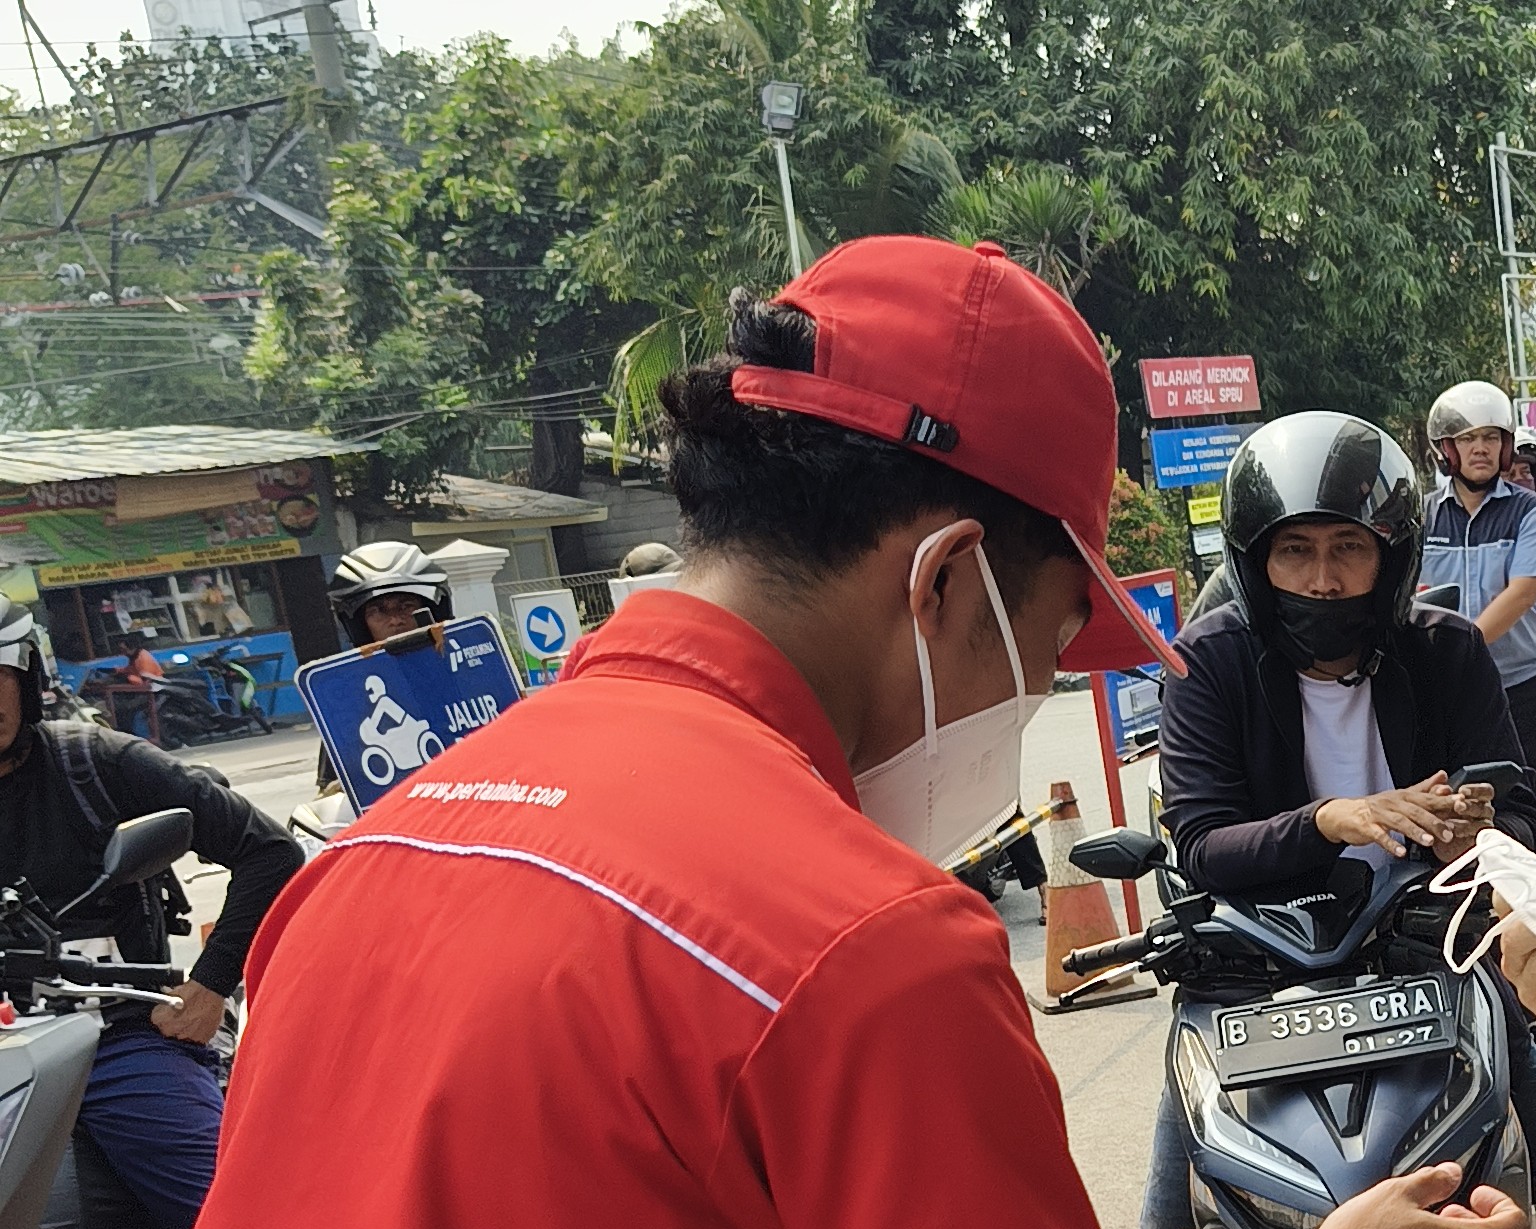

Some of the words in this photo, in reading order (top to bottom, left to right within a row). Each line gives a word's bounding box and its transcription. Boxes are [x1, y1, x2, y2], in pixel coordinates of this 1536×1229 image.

[1152, 368, 1203, 387] DILARANG
[1206, 367, 1251, 384] MEROKOK
[1167, 390, 1179, 407] DI
[1184, 389, 1216, 406] AREAL
[1219, 386, 1243, 403] SPBU
[444, 694, 501, 734] JALUR
[406, 779, 568, 808] www.pertamina.com
[1285, 892, 1338, 911] HONDA
[1228, 1018, 1248, 1046] B
[1270, 1001, 1359, 1040] 3536
[1369, 987, 1435, 1023] CRA
